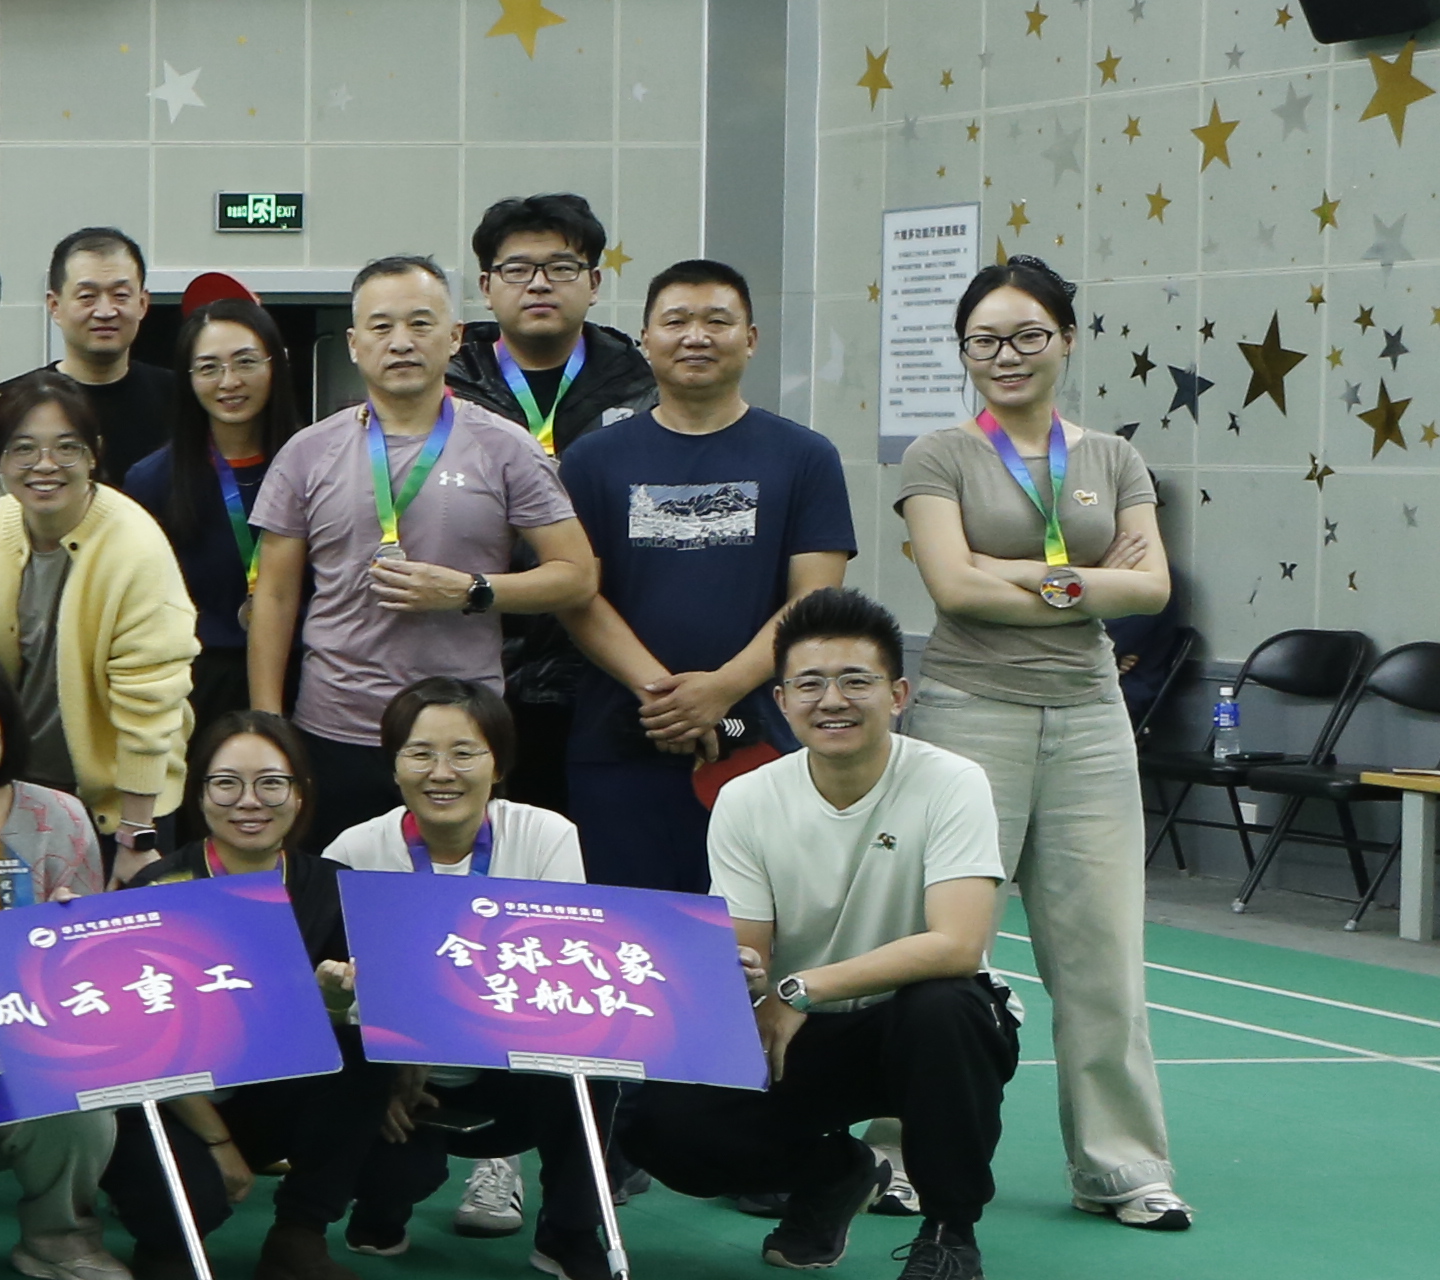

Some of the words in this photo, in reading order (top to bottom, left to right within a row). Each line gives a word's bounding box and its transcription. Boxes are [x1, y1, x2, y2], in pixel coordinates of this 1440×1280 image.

[277, 205, 297, 218] EXIT
[436, 933, 666, 985] 全球气象
[479, 973, 655, 1018] 导航队
